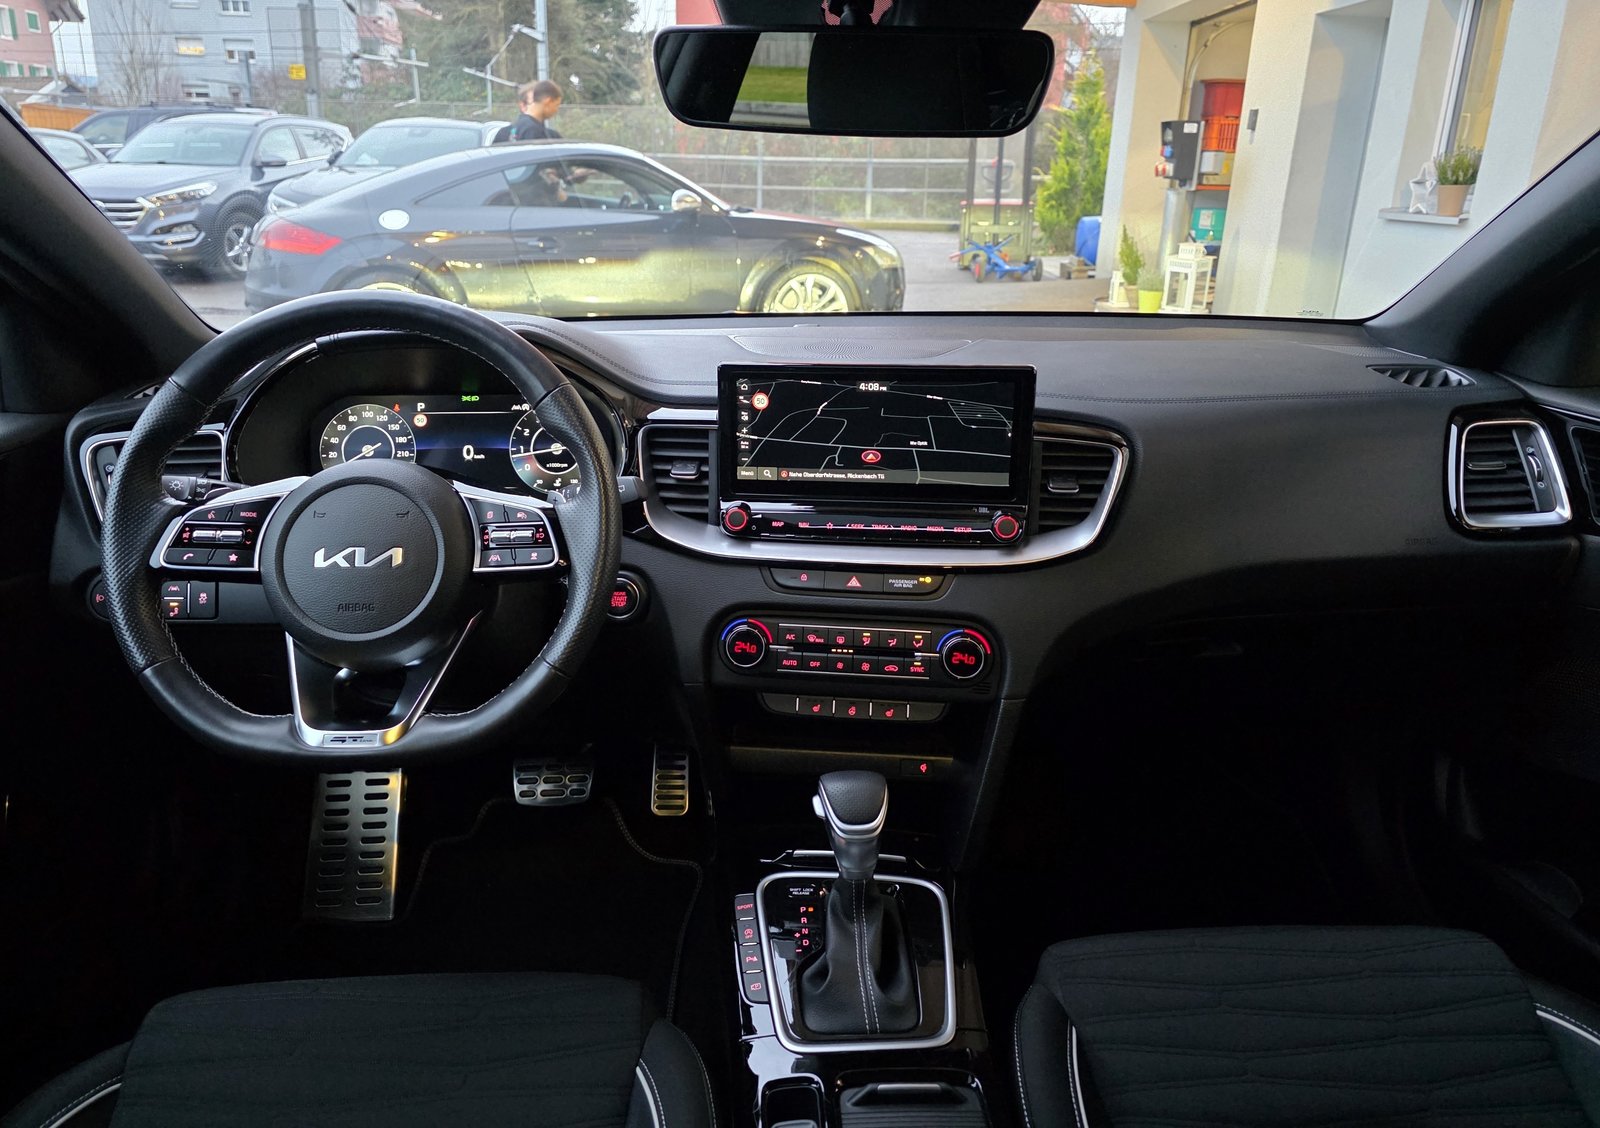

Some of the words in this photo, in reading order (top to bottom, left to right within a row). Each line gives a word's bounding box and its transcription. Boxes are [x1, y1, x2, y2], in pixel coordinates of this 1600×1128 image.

[859, 383, 879, 391] 4:08
[756, 397, 765, 405] 50
[417, 403, 425, 411] P
[463, 445, 474, 460] 0
[524, 463, 531, 471] 0
[314, 547, 403, 568] KIA
[337, 603, 376, 612] AIRBAG
[734, 641, 757, 653] 24.0
[952, 652, 976, 665] 24.0
